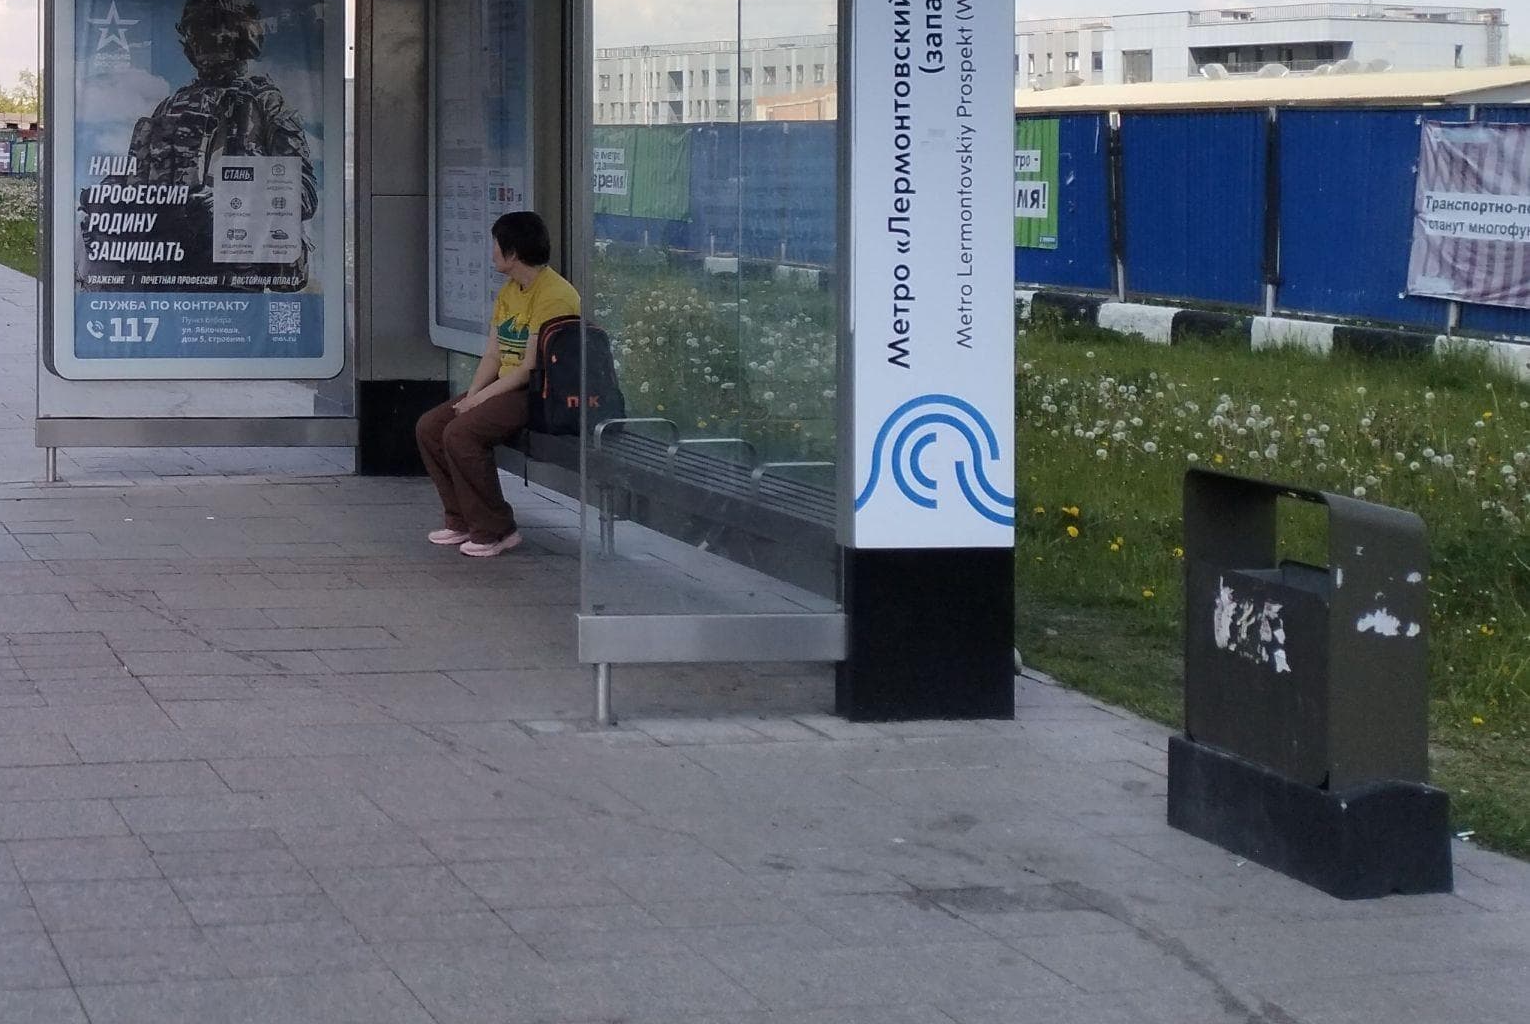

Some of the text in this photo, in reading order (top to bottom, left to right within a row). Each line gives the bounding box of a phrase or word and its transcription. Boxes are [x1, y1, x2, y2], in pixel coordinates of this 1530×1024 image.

[956, 26, 976, 117] Prospekt
[89, 156, 137, 176] НАША
[88, 184, 189, 205] ПРОФЕССИЯ
[956, 125, 976, 276] Lermontovskiy
[88, 213, 158, 235] РОДИНУ
[1428, 219, 1465, 235] станут
[88, 241, 185, 263] ЗАЩИЩАТЬ
[87, 275, 125, 285] УВАЖЕНИЕ
[176, 275, 218, 285] ПРОФЕССИЯ
[90, 300, 250, 311] СЛУЖБА ПО КОНТРАКТУ
[887, 263, 916, 369] Метро
[956, 284, 973, 349] Metro
[109, 317, 160, 343] 117
